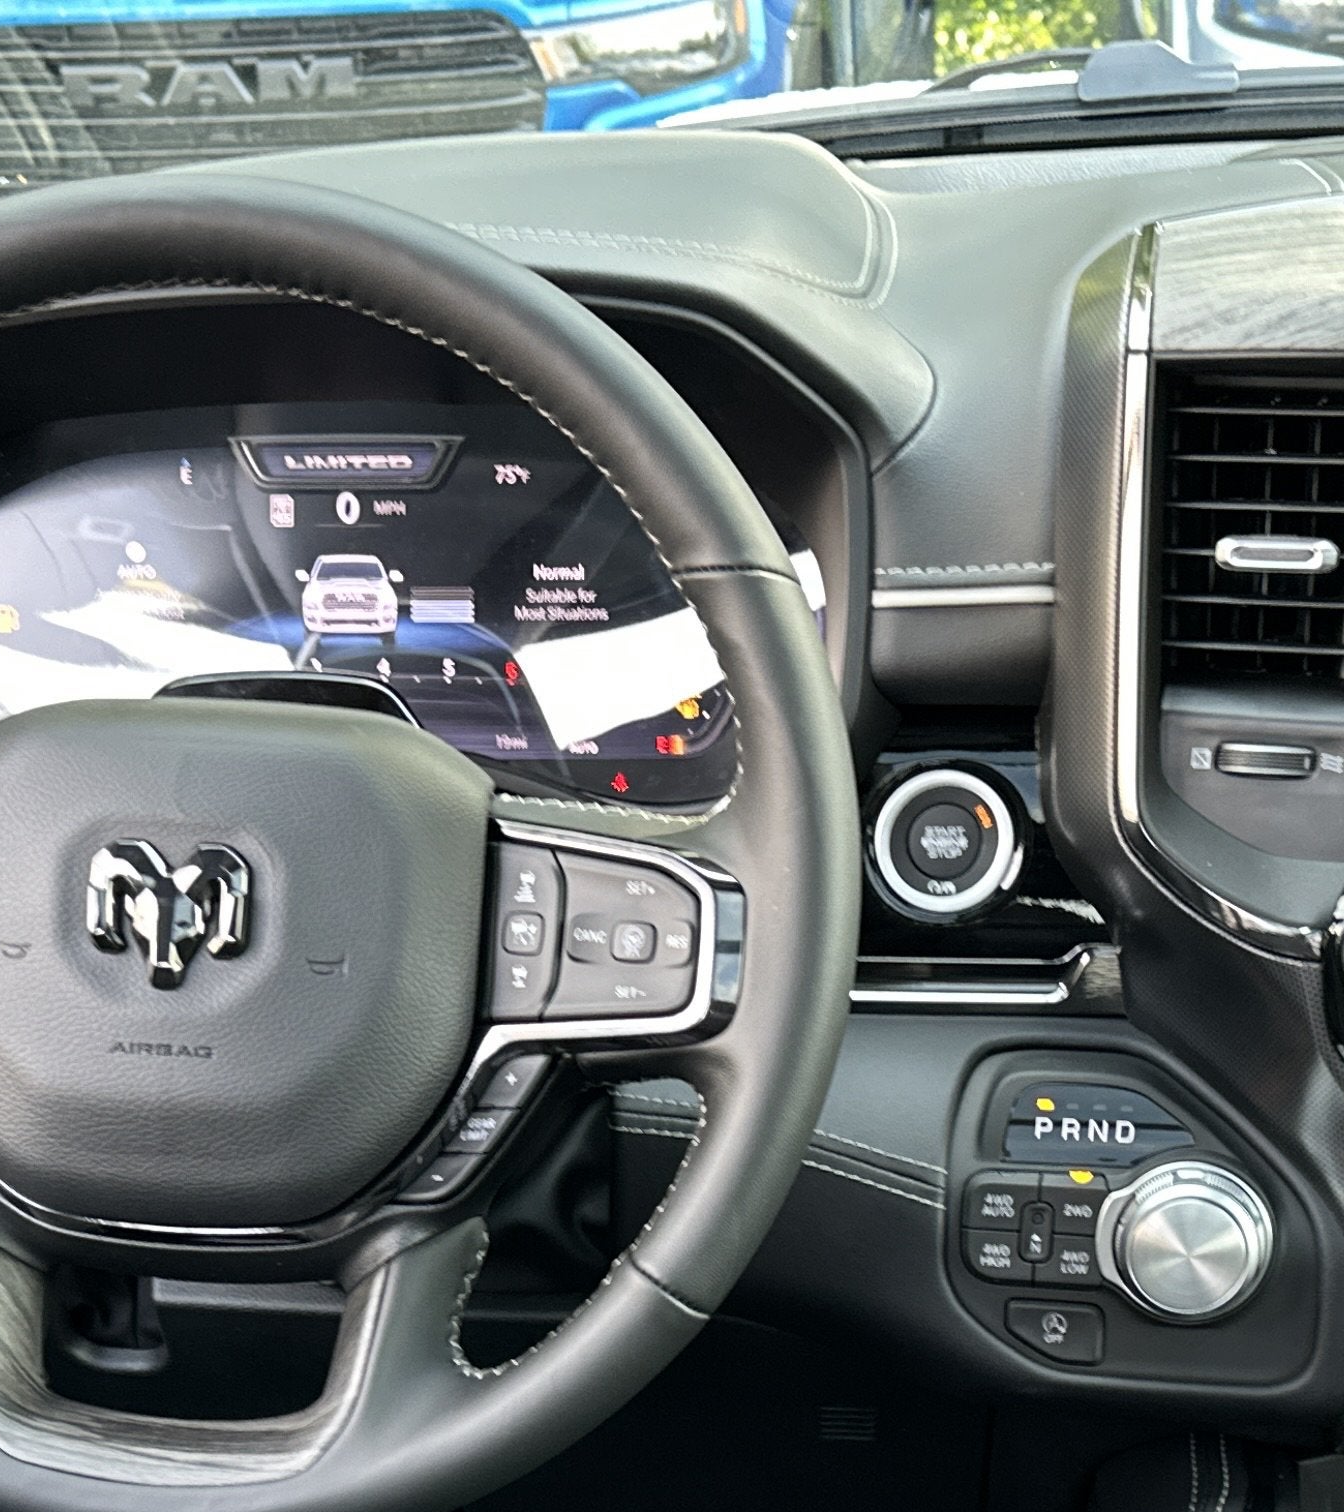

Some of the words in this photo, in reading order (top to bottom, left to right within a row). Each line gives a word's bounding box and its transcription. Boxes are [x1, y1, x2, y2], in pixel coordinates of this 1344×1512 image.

[60, 57, 355, 106] RAM
[284, 455, 413, 470] LIMITED
[336, 491, 361, 525] 0
[532, 563, 586, 581] Normal
[525, 587, 577, 604] Suitable
[578, 587, 597, 604] for
[514, 605, 548, 621] Most
[549, 605, 610, 622] Situations
[108, 1041, 215, 1060] AIRBAG
